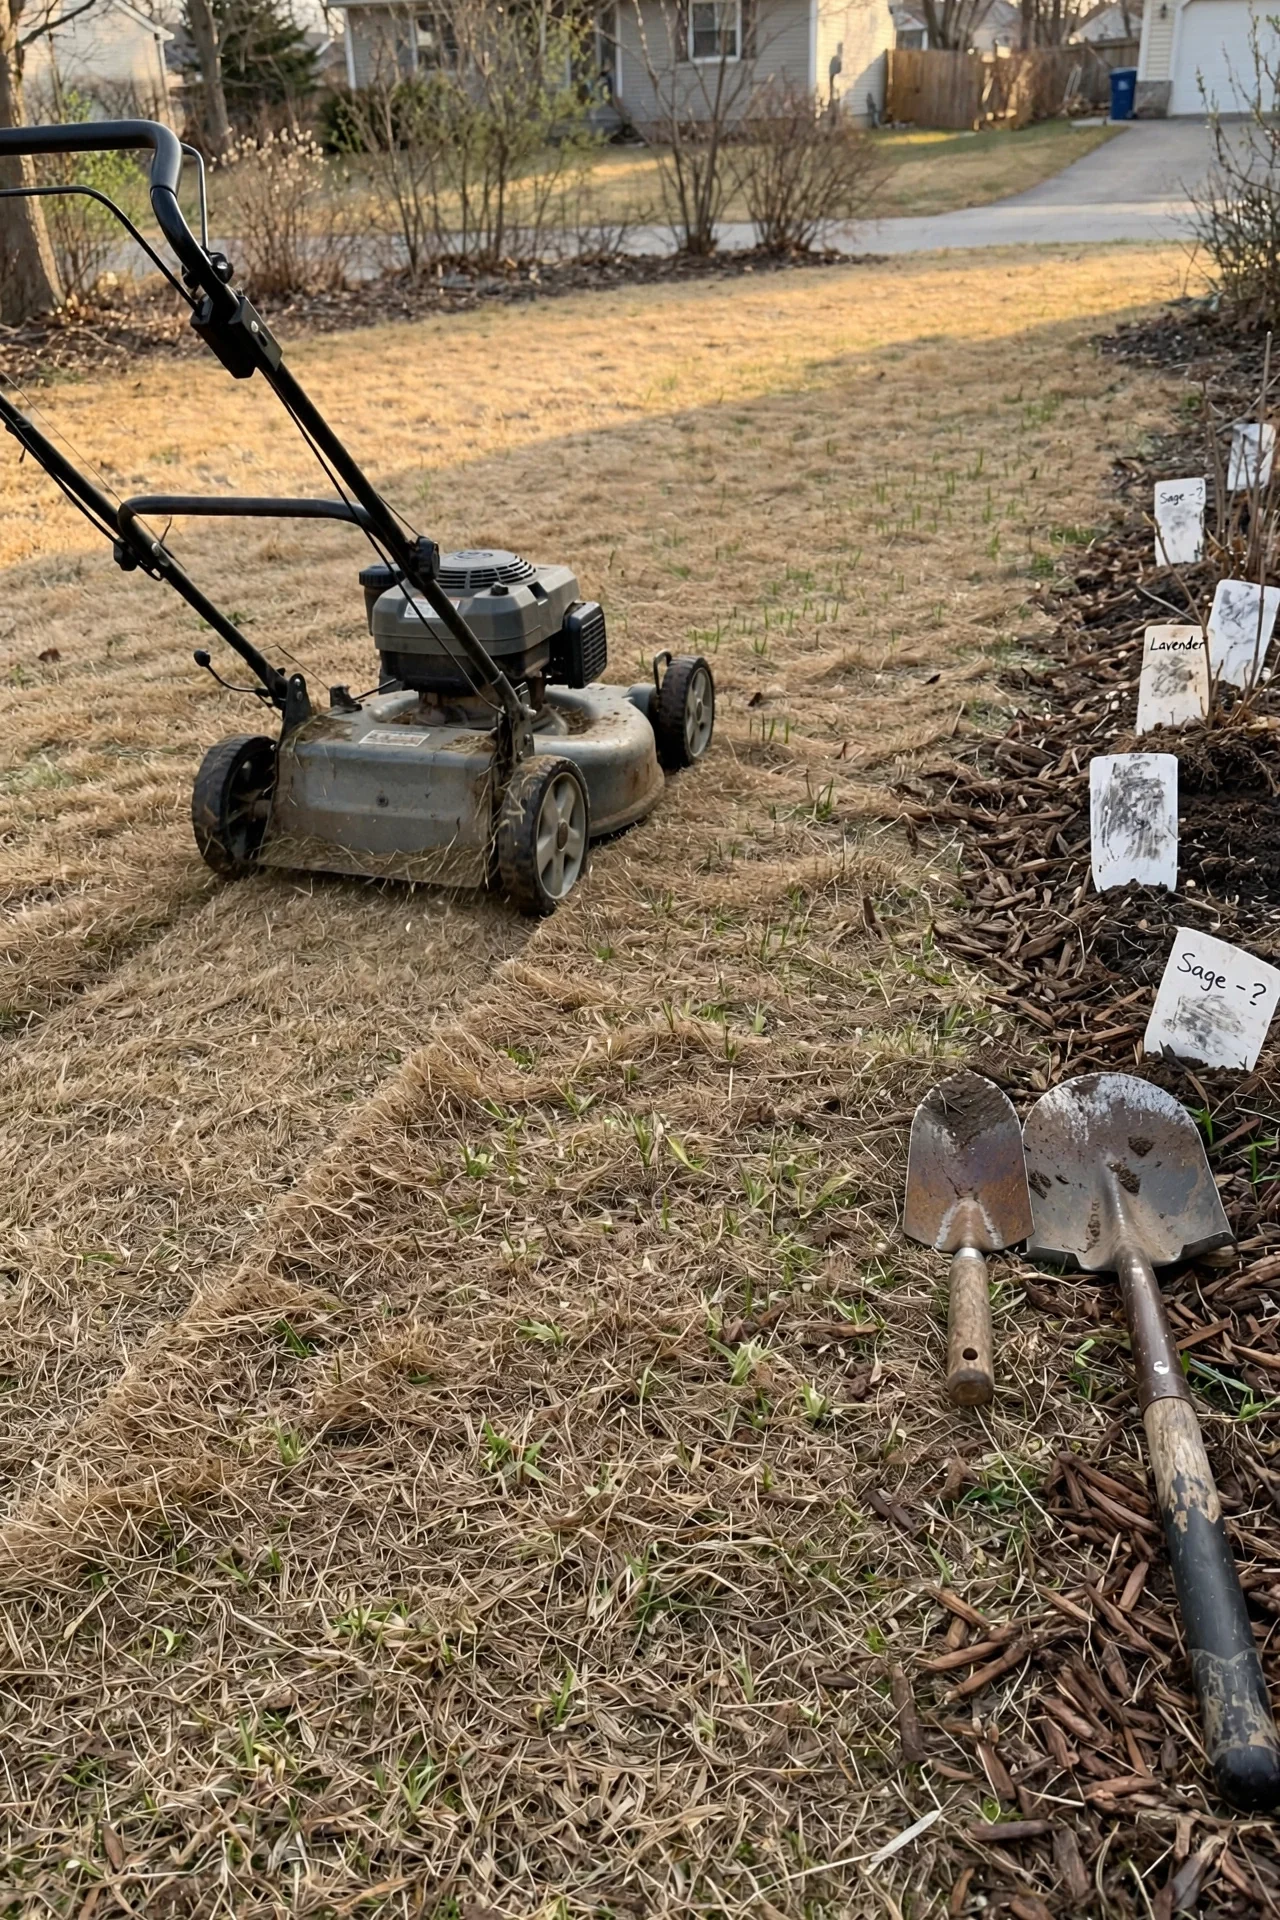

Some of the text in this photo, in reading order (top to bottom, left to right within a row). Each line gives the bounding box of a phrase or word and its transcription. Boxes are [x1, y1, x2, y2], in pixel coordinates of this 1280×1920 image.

[1160, 492, 1185, 506] Sage
[1150, 635, 1205, 651] Lavender
[1177, 952, 1226, 991] Sage
